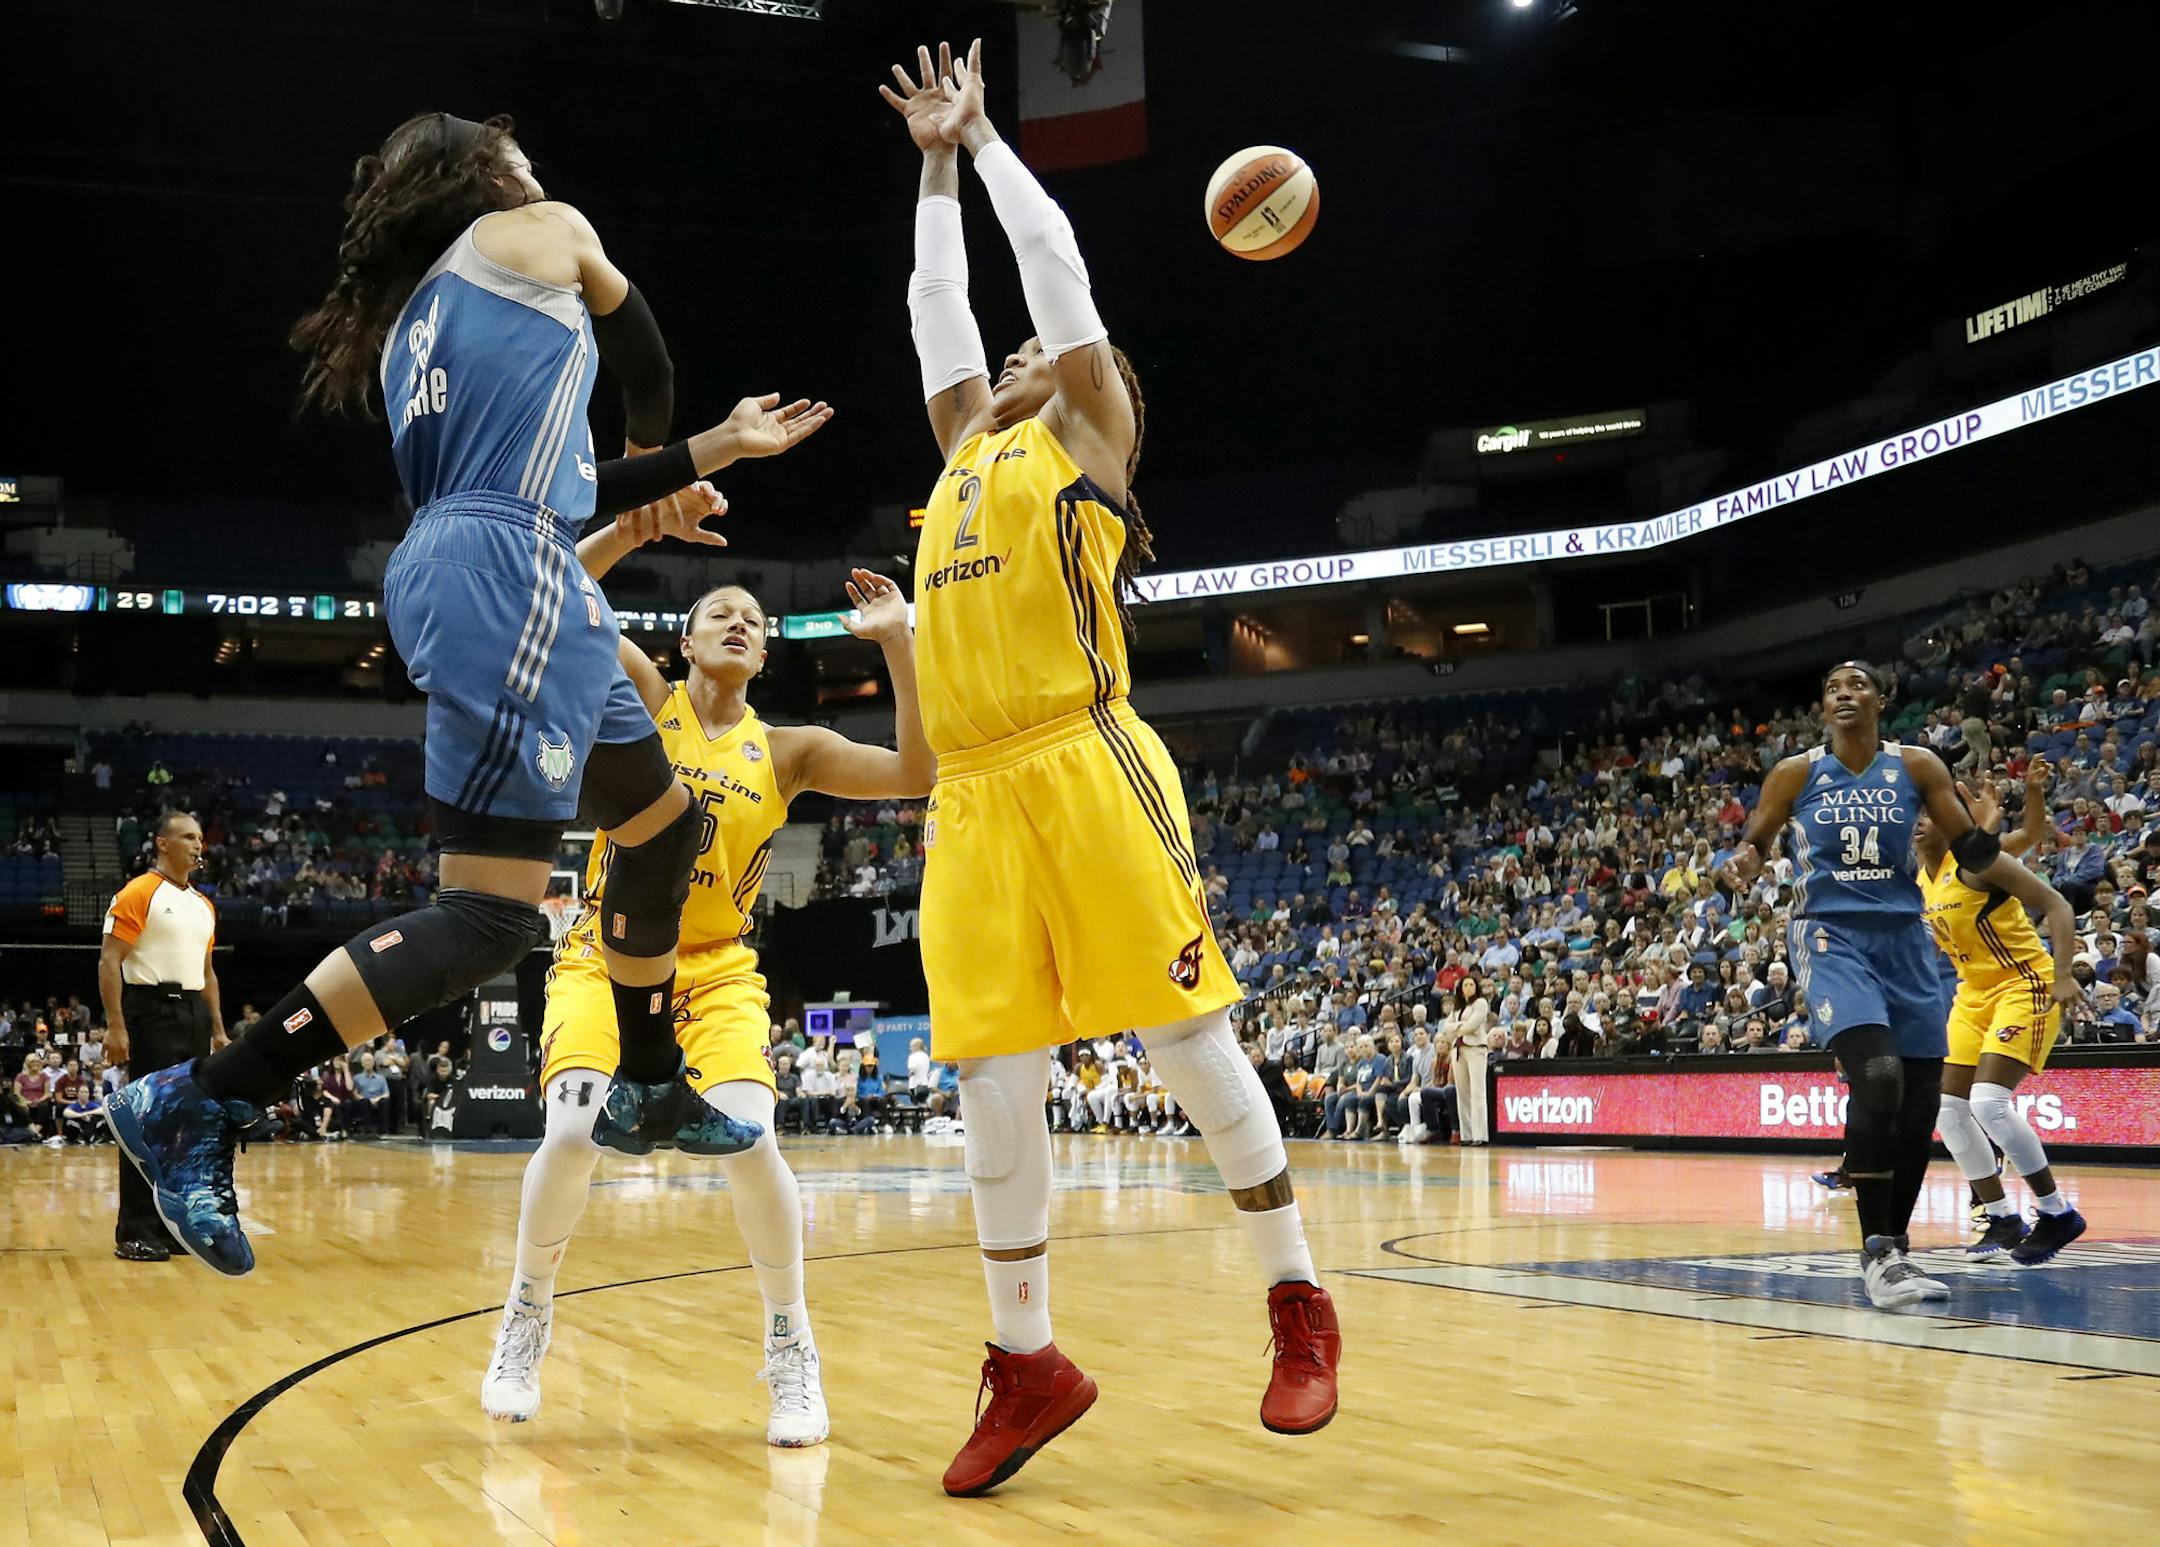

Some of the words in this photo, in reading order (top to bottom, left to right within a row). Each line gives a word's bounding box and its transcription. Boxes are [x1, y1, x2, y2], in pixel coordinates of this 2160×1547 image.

[1219, 162, 1286, 224] SPALDING
[2021, 350, 2160, 422] MESSER
[1477, 429, 1530, 453] Cargill
[1403, 535, 1553, 571] MESSERLI
[1565, 533, 1584, 553] &
[1595, 508, 1702, 551] KRAMER
[1716, 474, 1800, 522] FAMILY
[1811, 451, 1869, 492] LAW
[1880, 413, 1982, 467] GROUP
[954, 475, 981, 550] 2
[924, 555, 1000, 591] verizon
[1175, 570, 1237, 595] LAW
[1250, 558, 1354, 588] GROUP
[117, 592, 153, 609] 29
[207, 594, 279, 615] 7:02
[344, 600, 375, 617] 21
[805, 621, 833, 631] 2ND
[1821, 788, 1898, 807] MAYO
[1814, 806, 1905, 824] CLINIC
[1840, 825, 1880, 865] 34
[1831, 866, 1892, 881] verizon
[886, 1022, 913, 1032] PARTY
[917, 1022, 930, 1031] ZO
[468, 1085, 525, 1100] verizon
[1504, 1088, 1594, 1124] verizon
[1760, 1083, 1850, 1126] Bett
